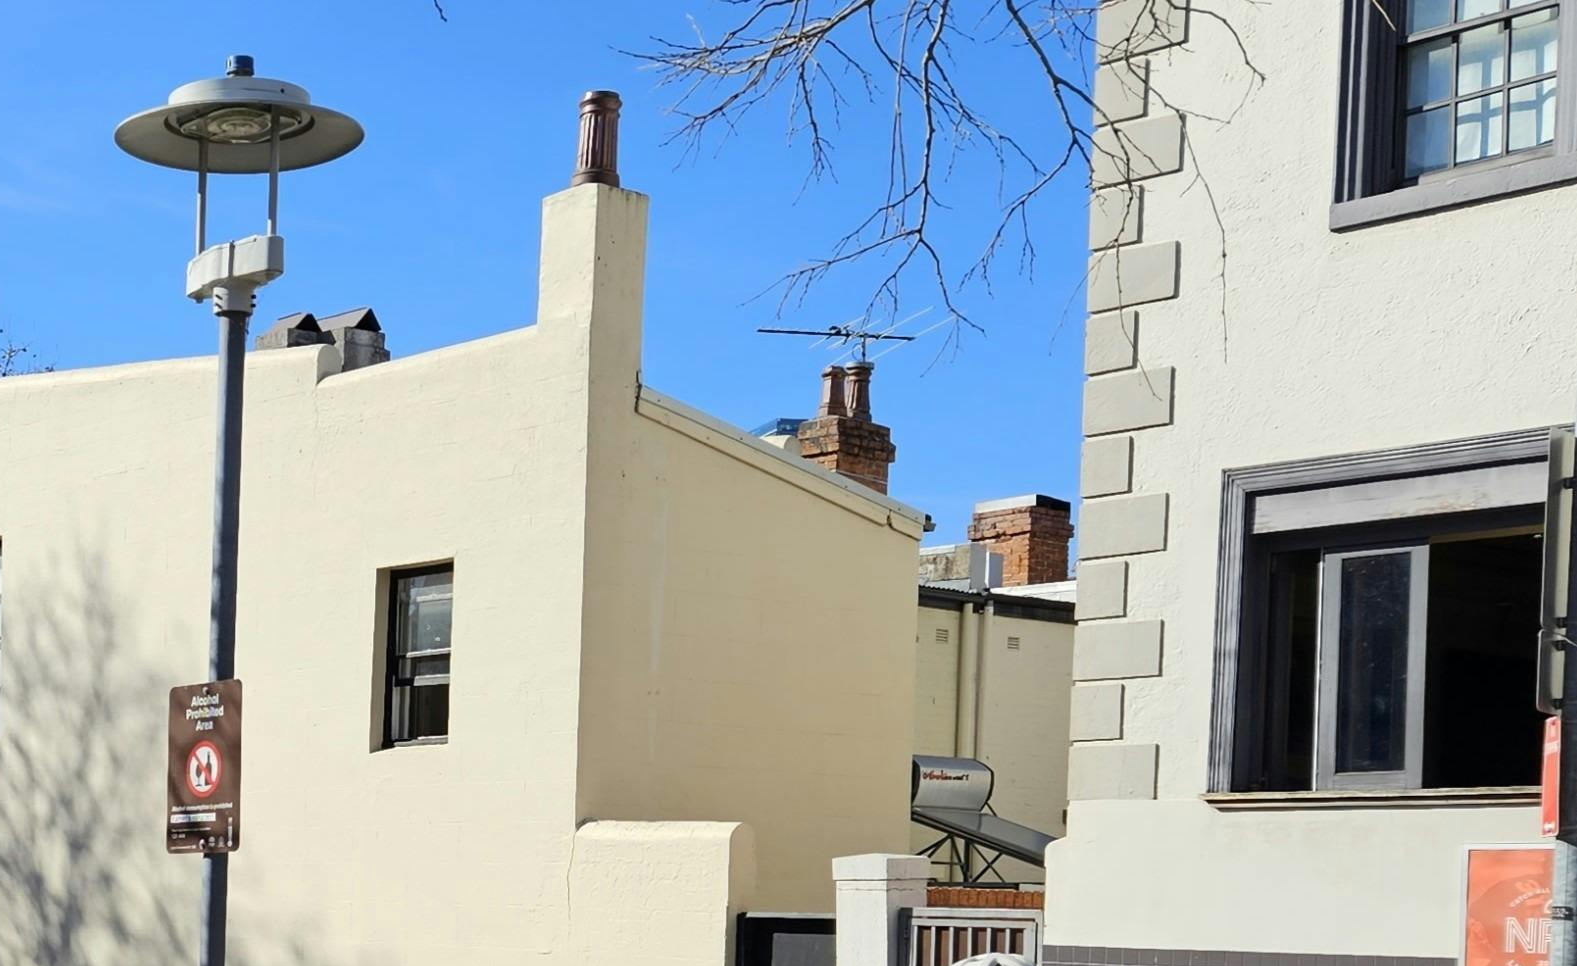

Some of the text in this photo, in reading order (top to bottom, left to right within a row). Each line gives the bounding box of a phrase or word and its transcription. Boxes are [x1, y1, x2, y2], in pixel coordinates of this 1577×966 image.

[191, 693, 220, 707] Alcohol
[185, 705, 224, 720] Prohibited
[195, 720, 214, 731] Area
